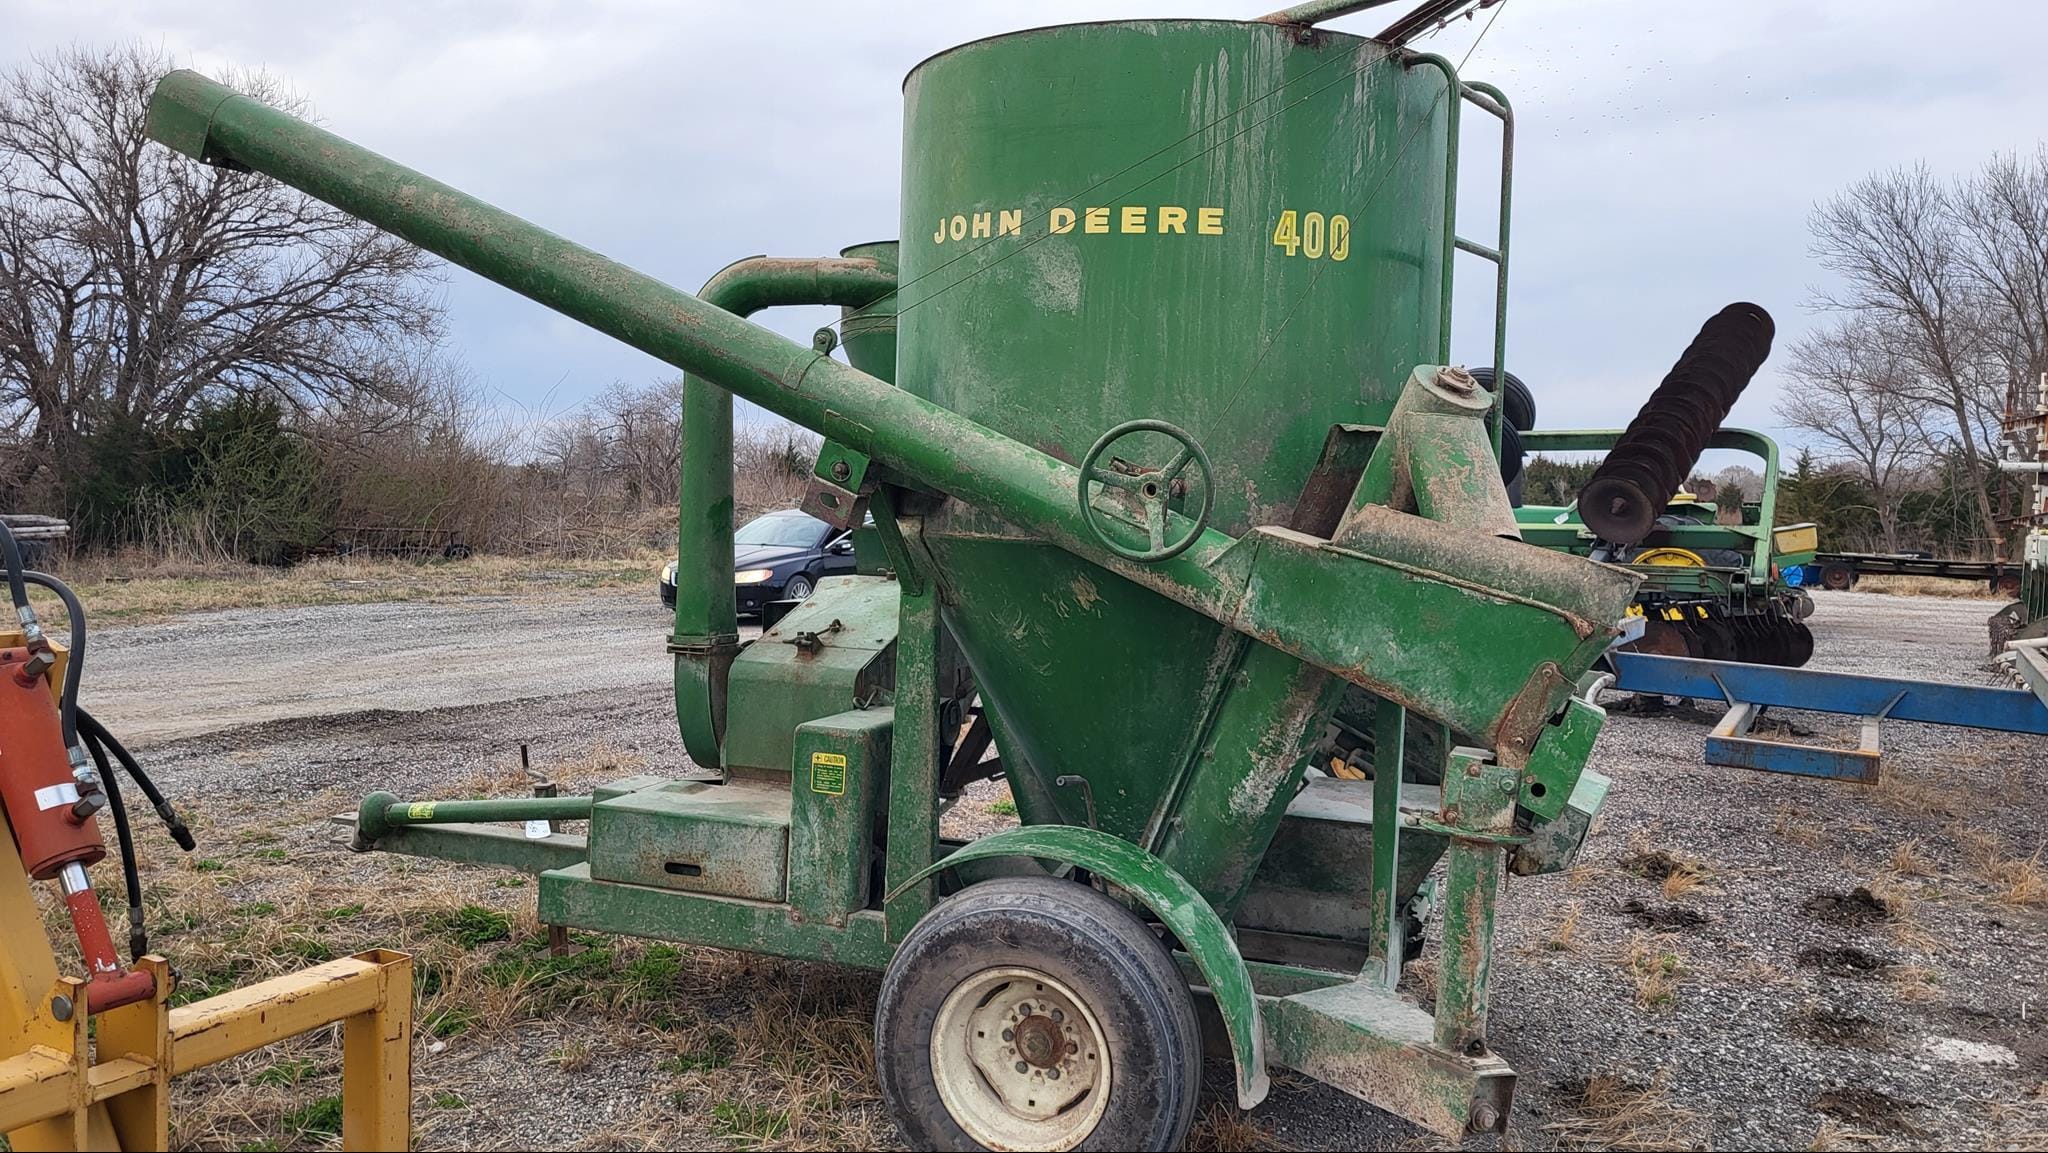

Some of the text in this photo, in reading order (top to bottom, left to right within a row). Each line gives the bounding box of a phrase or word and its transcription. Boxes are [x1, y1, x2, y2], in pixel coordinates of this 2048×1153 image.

[933, 206, 1224, 244] JOHN DEERE
[1273, 210, 1350, 261] 400
